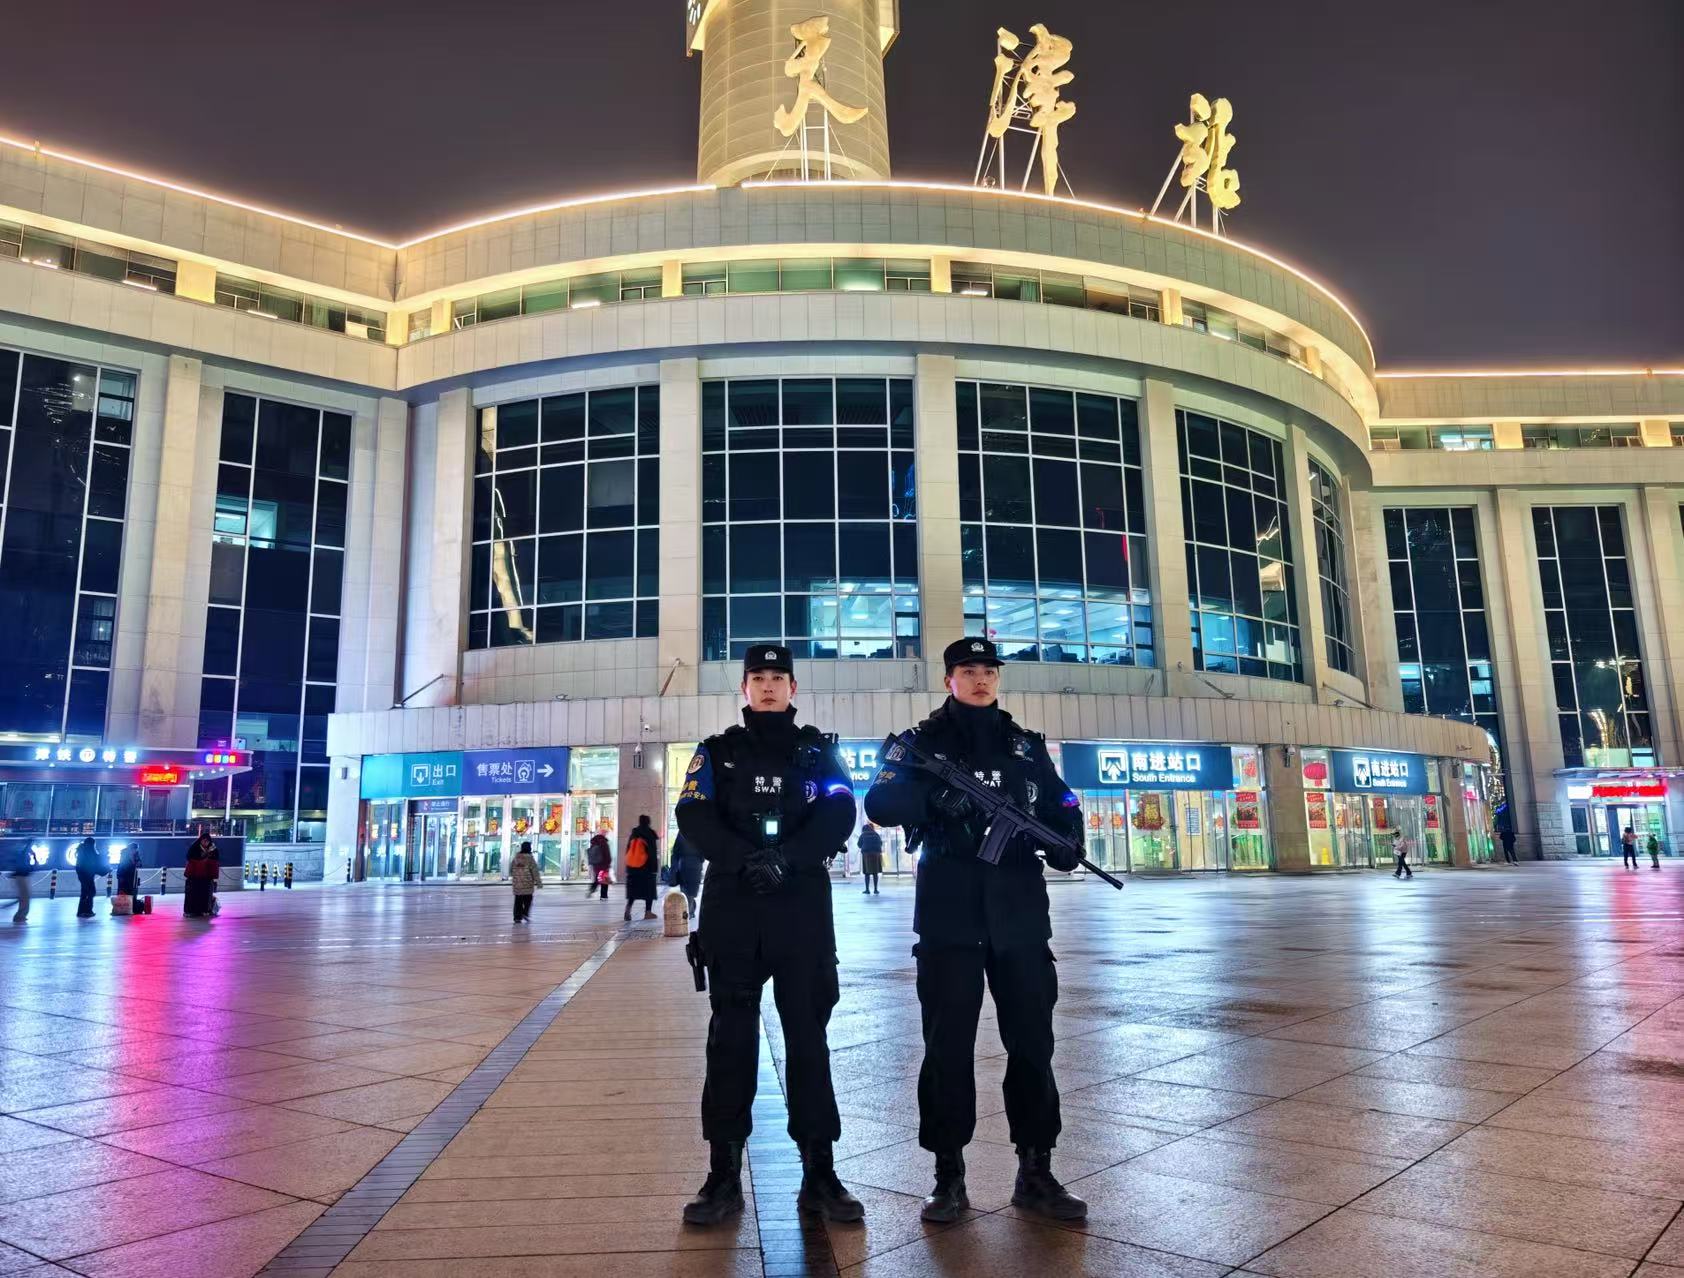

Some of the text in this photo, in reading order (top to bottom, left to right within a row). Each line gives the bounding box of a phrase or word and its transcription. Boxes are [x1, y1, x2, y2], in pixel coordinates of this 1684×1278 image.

[773, 15, 1241, 210] 天津站
[1132, 752, 1201, 771] 南进站口
[1371, 759, 1408, 777] 南进站口
[433, 764, 456, 777] 出口
[477, 762, 513, 776] 售票处
[755, 776, 782, 787] 特警
[1132, 773, 1196, 782] South Entrance
